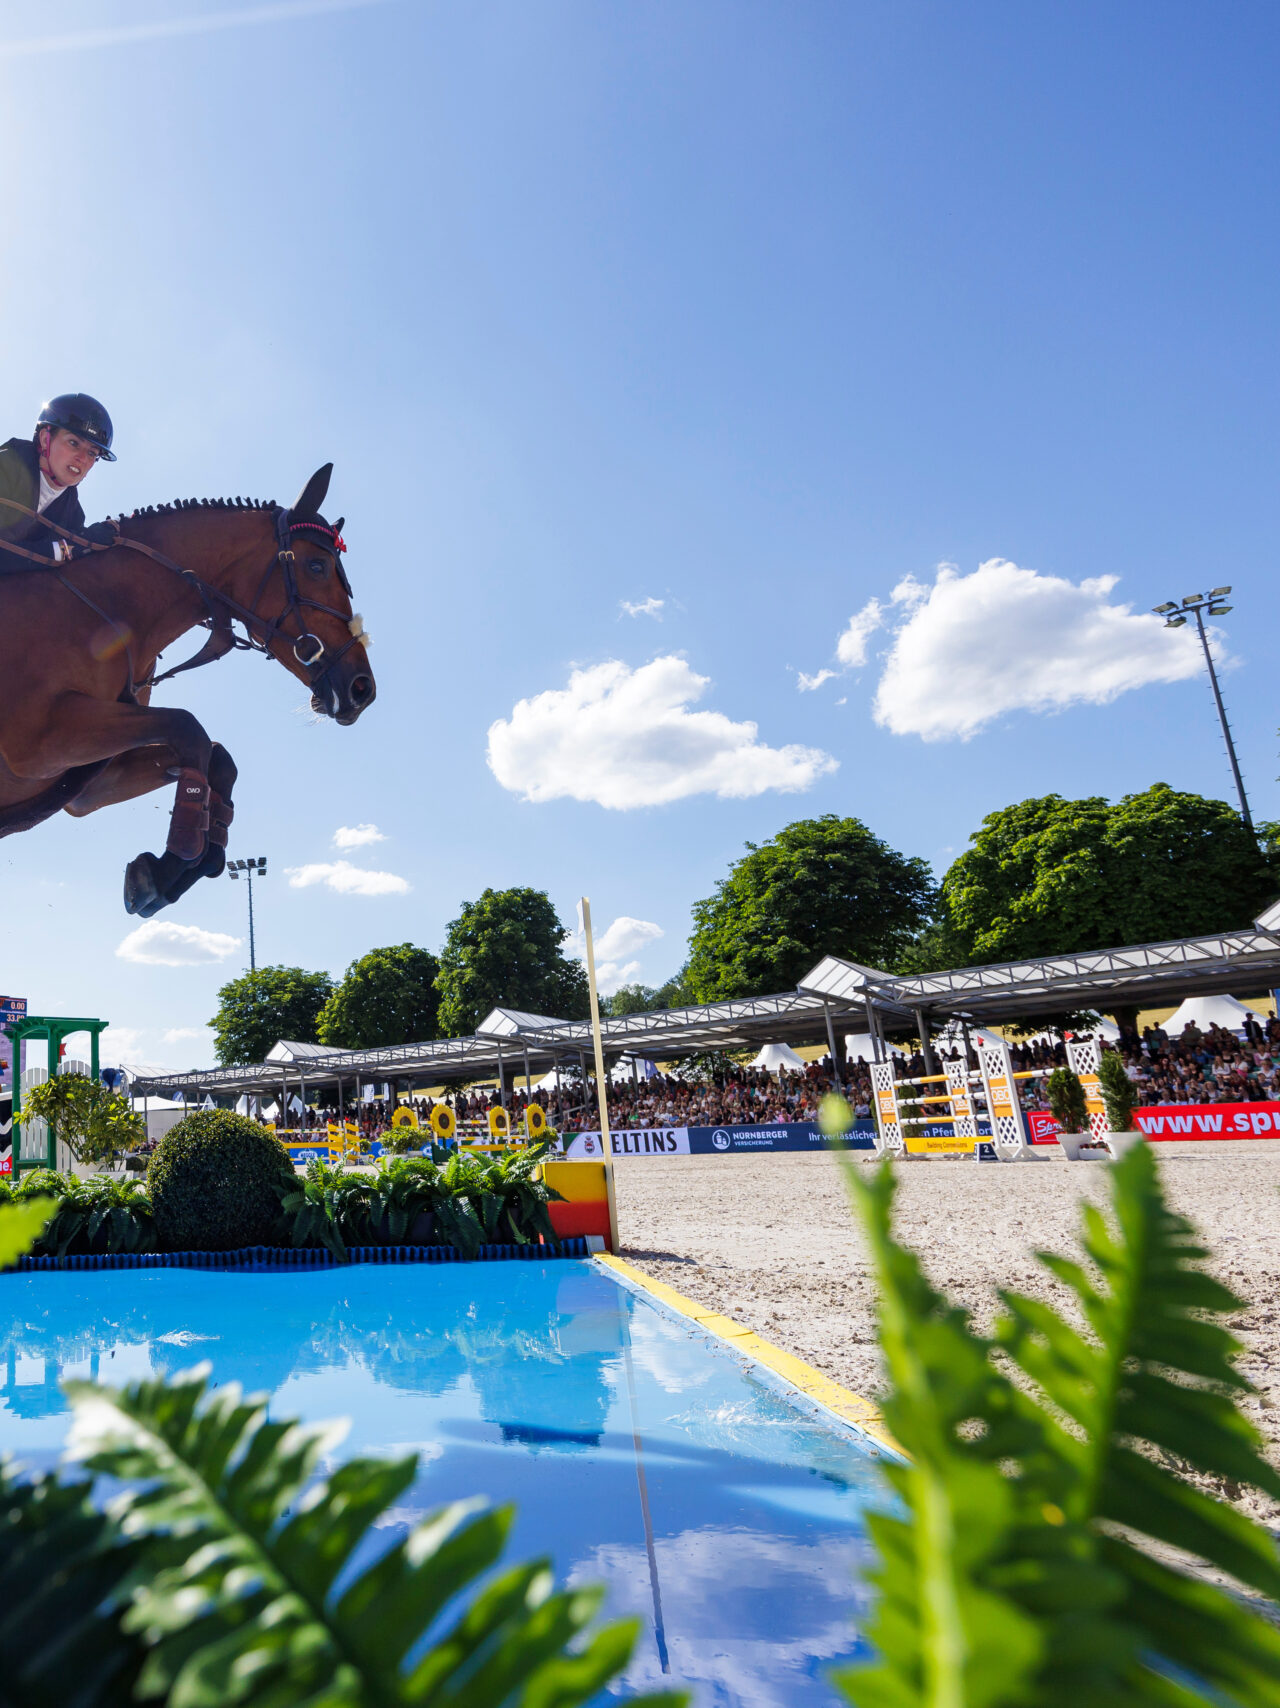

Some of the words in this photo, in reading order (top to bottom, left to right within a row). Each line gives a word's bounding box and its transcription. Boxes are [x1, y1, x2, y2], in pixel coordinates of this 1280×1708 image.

[10, 1001, 25, 1010] 0.00
[732, 1130, 788, 1140] NÜRNBERGER
[808, 1132, 821, 1142] Ihr
[983, 1144, 990, 1153] 2
